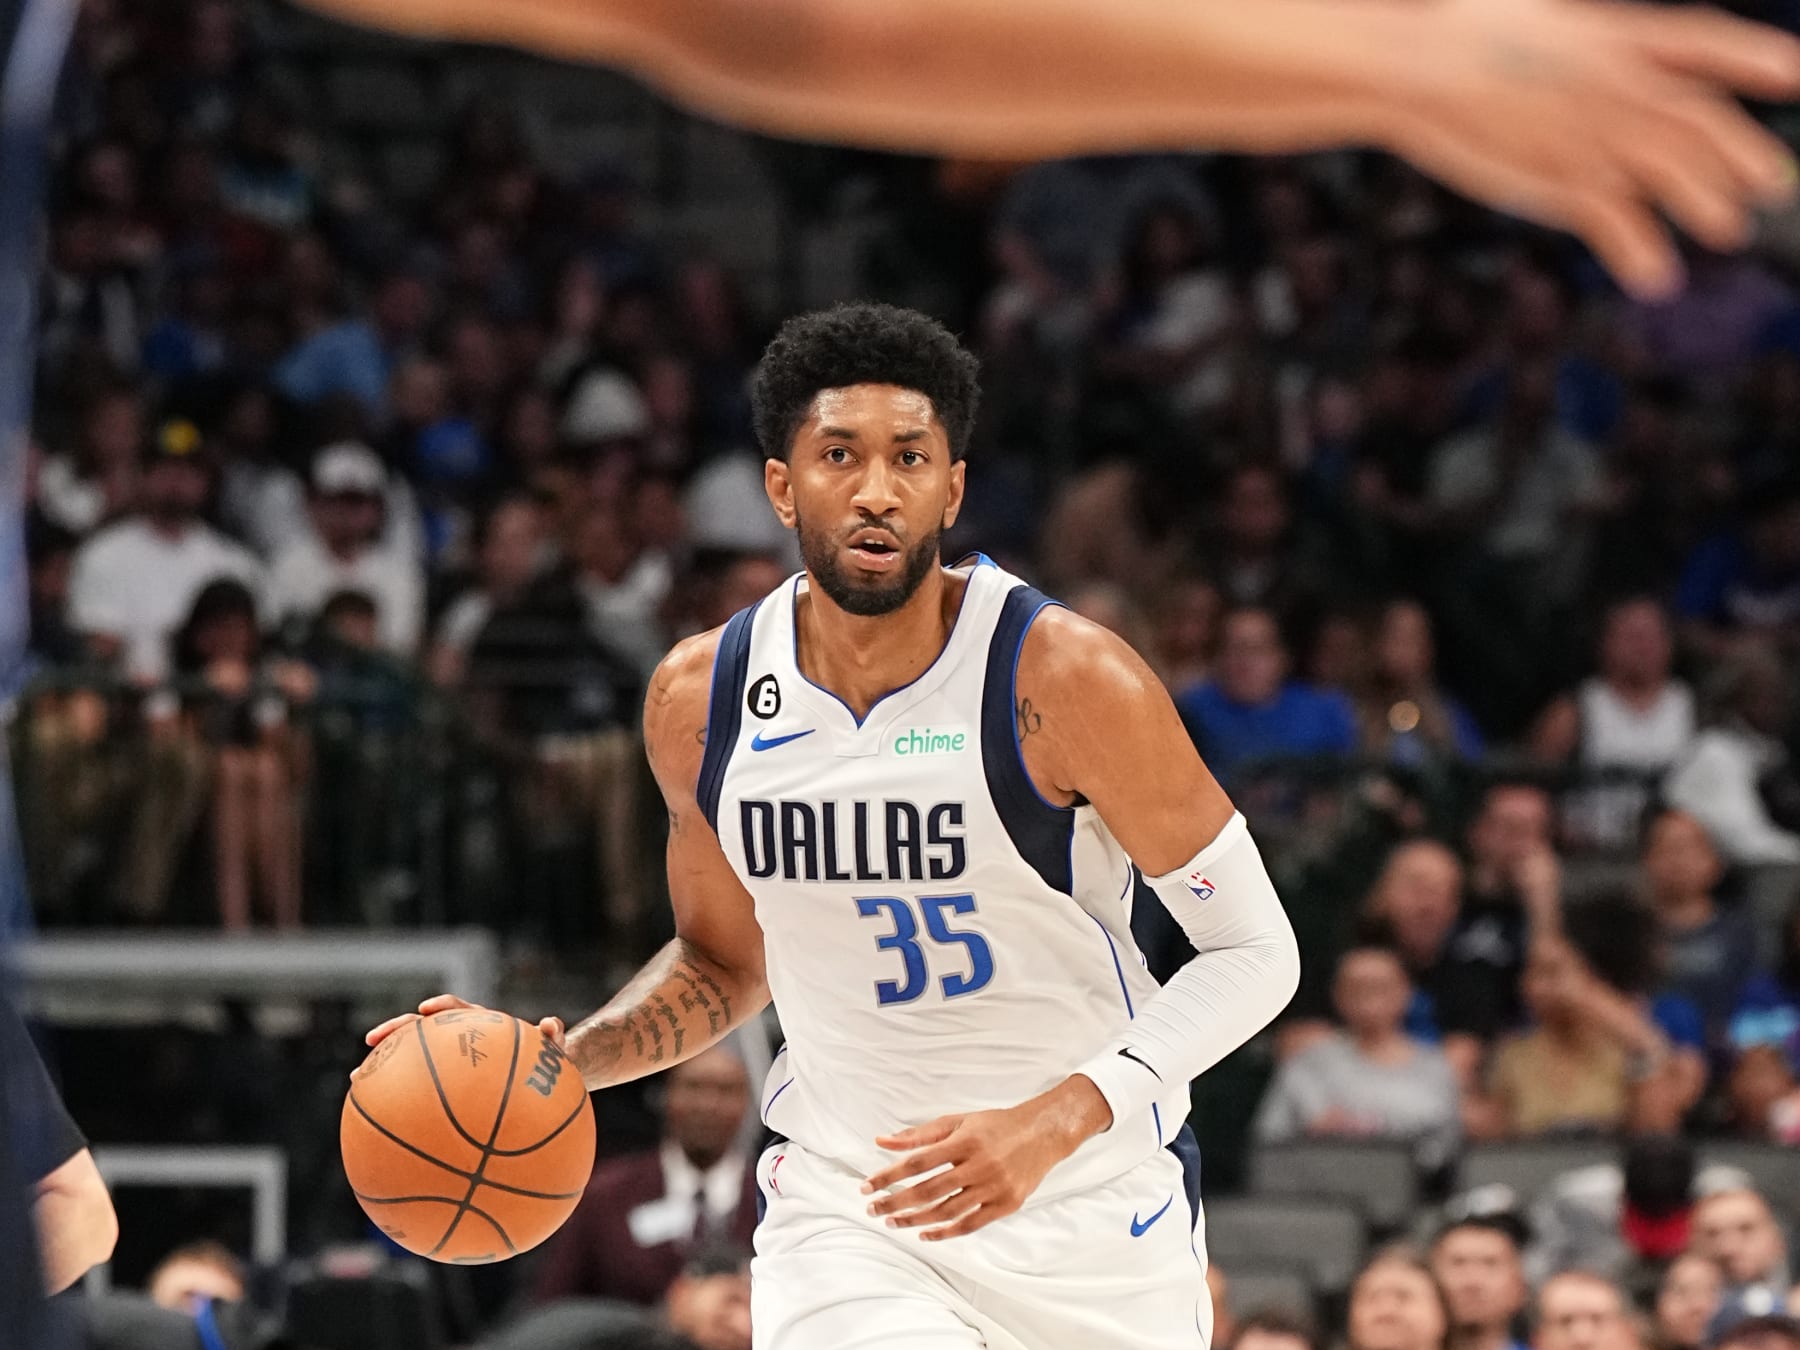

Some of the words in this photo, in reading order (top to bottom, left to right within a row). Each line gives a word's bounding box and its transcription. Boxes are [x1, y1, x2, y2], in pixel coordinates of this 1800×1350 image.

[756, 680, 777, 714] 6
[895, 728, 965, 755] chime
[739, 799, 967, 882] DALLAS
[853, 892, 996, 1007] 35
